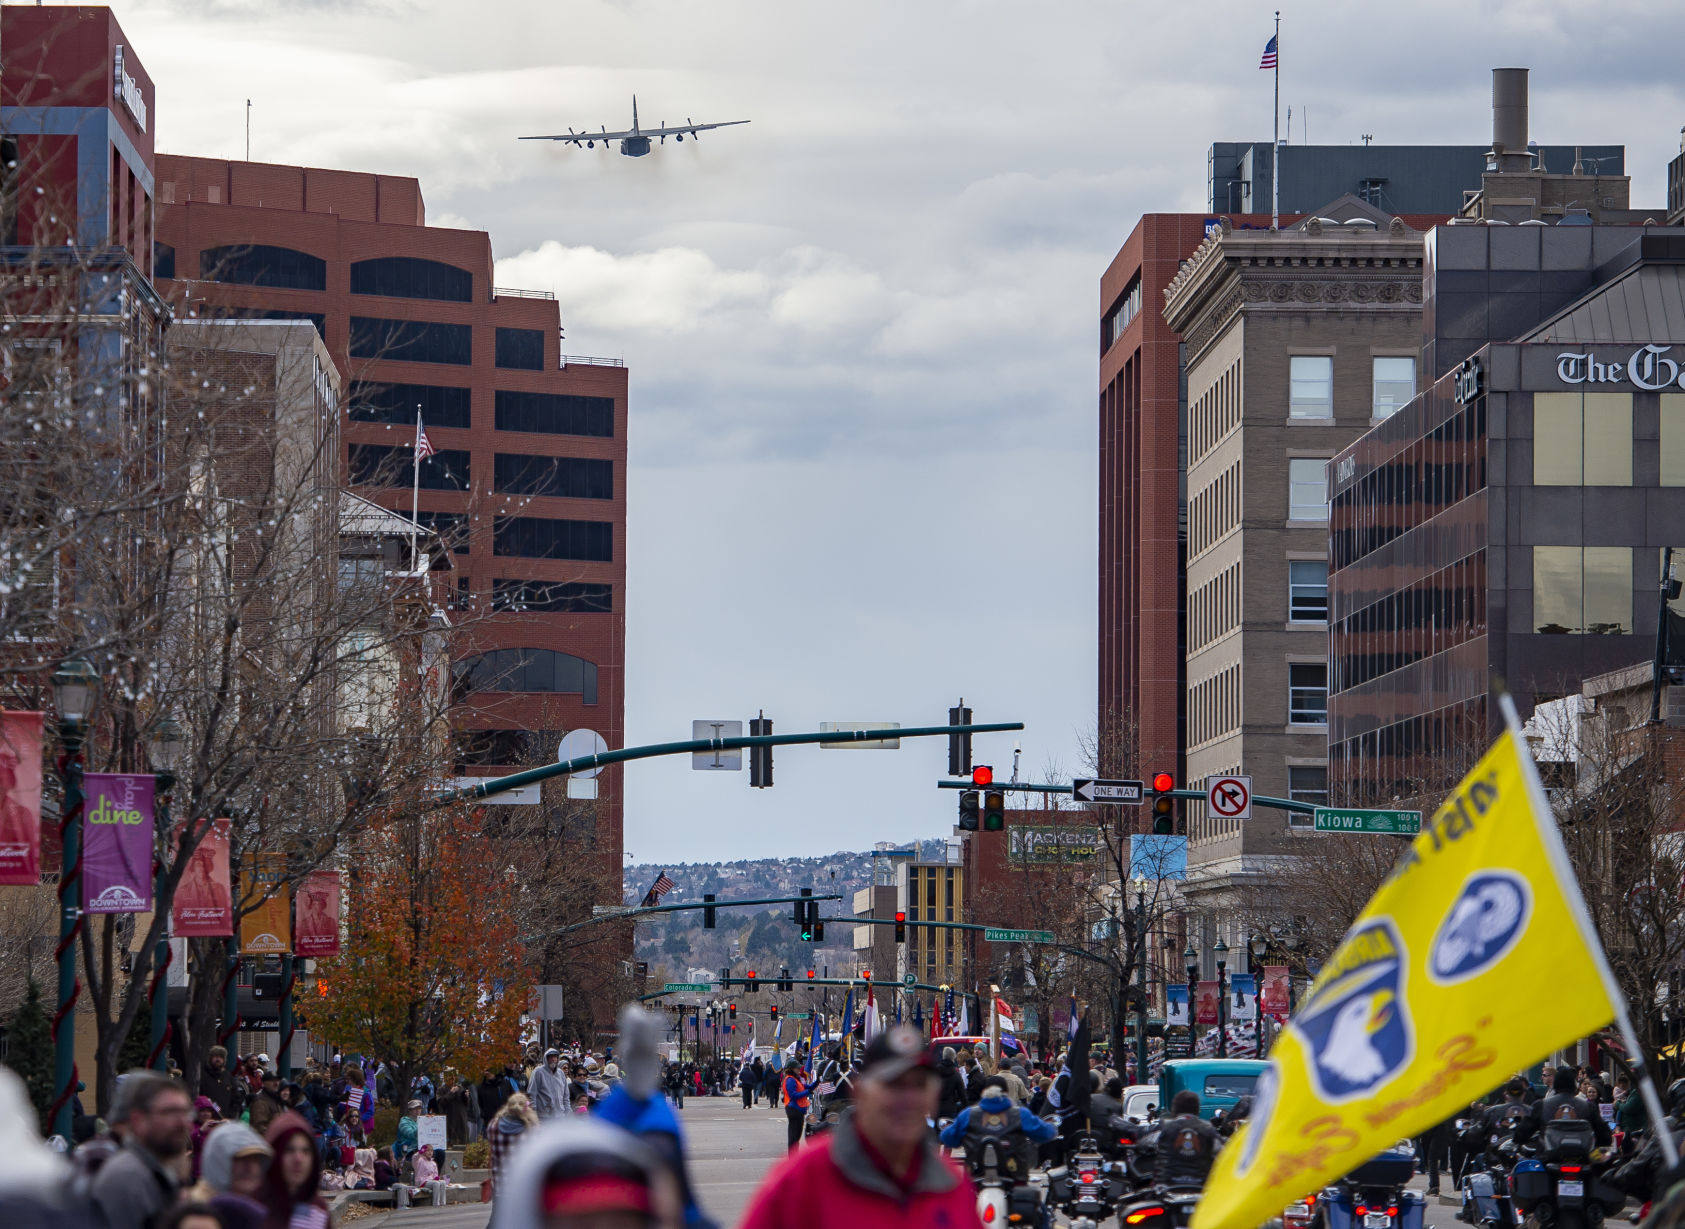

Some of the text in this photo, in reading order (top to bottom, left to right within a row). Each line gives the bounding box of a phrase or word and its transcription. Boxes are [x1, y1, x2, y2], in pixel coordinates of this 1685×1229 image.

[1556, 352, 1623, 384] The
[1094, 786, 1136, 797] ONE WAY
[88, 793, 144, 825] dine
[1318, 812, 1363, 829] Kiowa
[1397, 813, 1411, 821] 100
[1398, 824, 1412, 832] 100
[89, 898, 146, 907] DOWNTOWN
[986, 930, 1008, 940] Pikes
[1010, 932, 1029, 940] Peak
